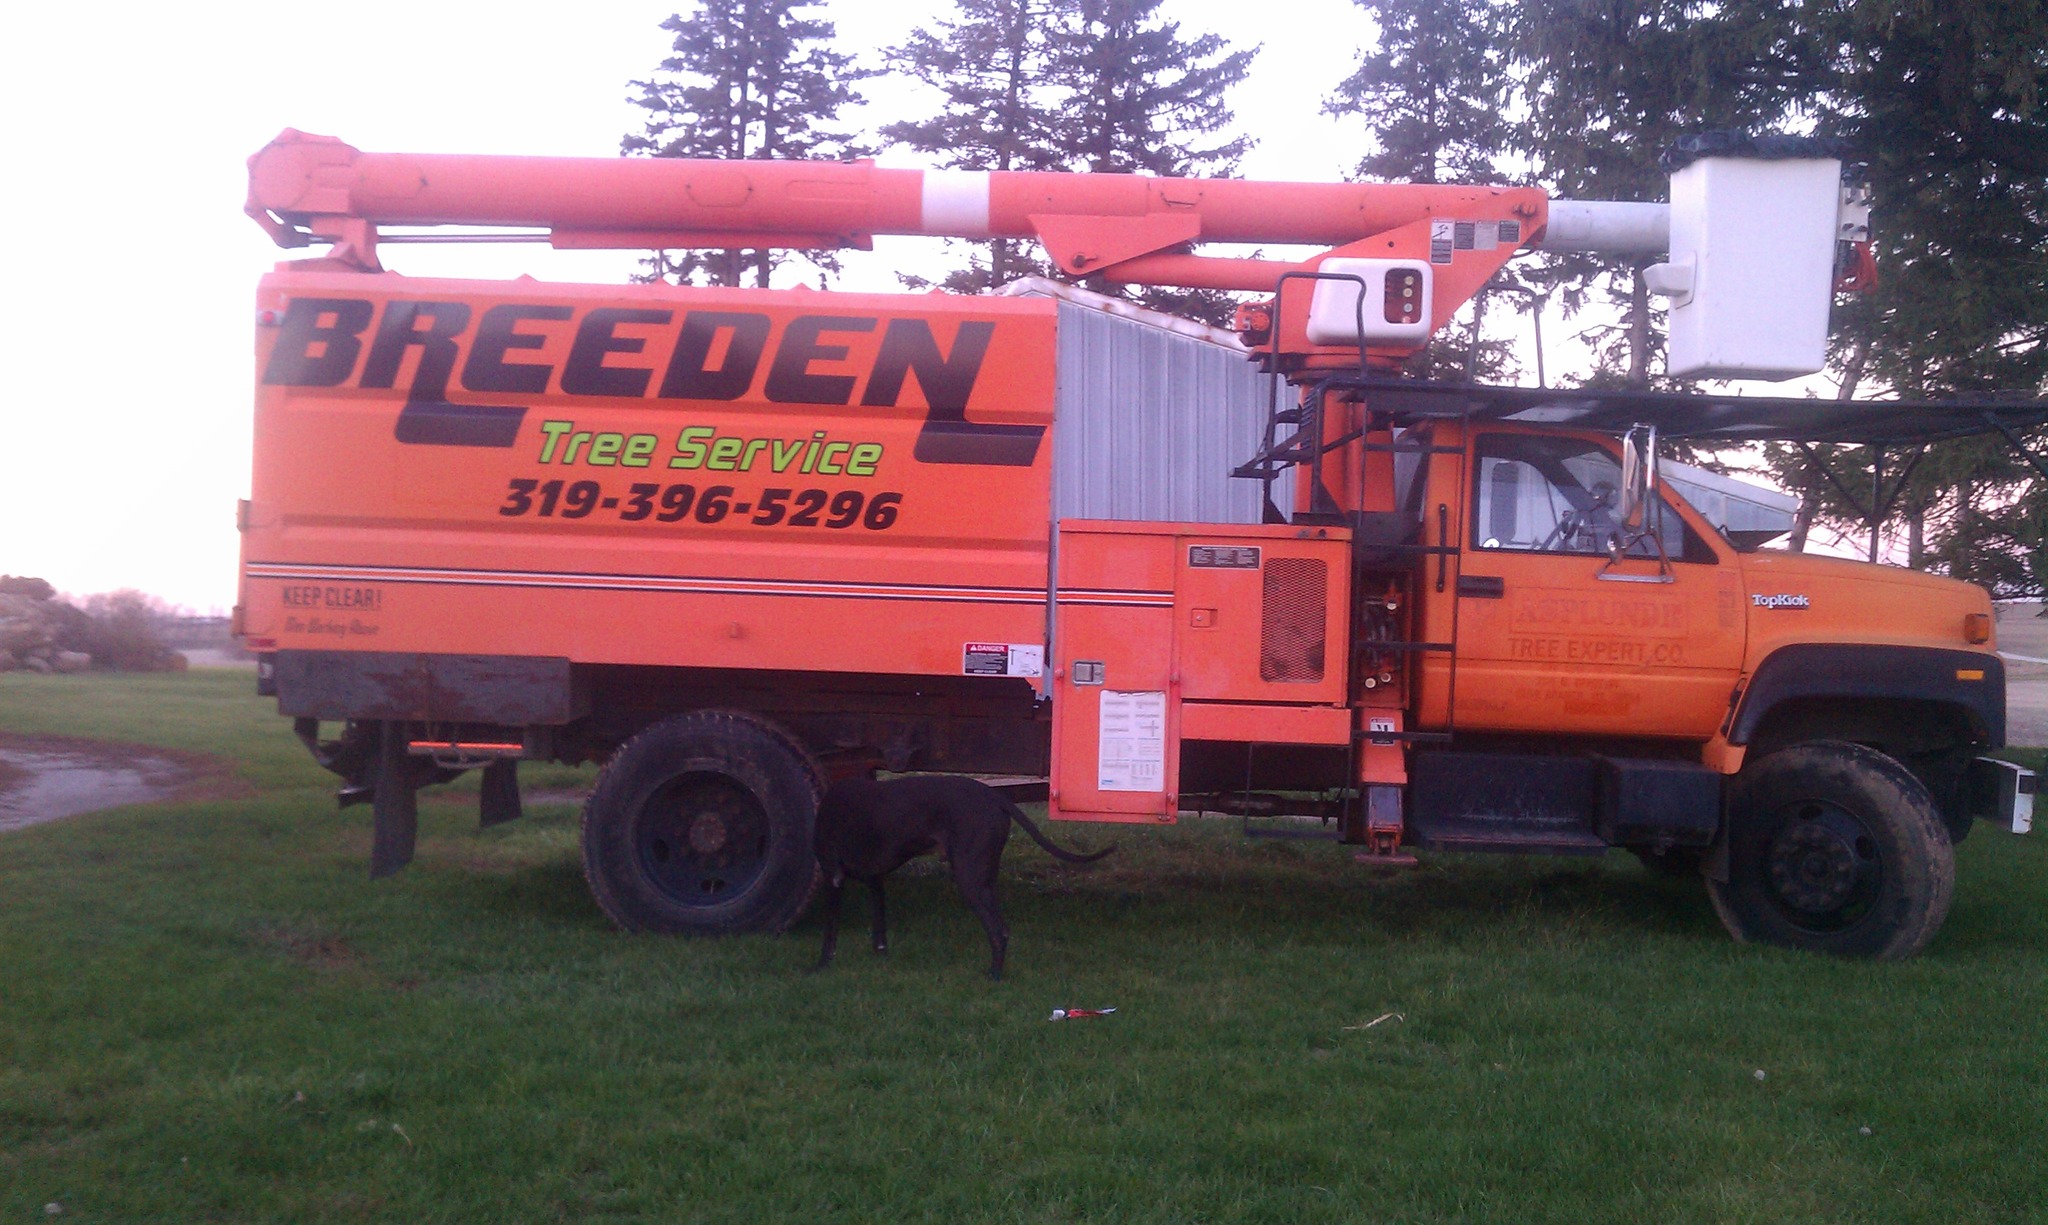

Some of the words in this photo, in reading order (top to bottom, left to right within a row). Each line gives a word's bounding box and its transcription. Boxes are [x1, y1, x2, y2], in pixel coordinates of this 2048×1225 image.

[262, 297, 1048, 467] BREEDEN
[538, 419, 658, 468] Tree
[668, 424, 884, 477] Service
[499, 478, 904, 532] 319-396-5296
[283, 586, 321, 606] KEEP
[1751, 593, 1810, 609] TopKick
[1507, 637, 1559, 658] TREE
[1568, 640, 1648, 662] EXPERT
